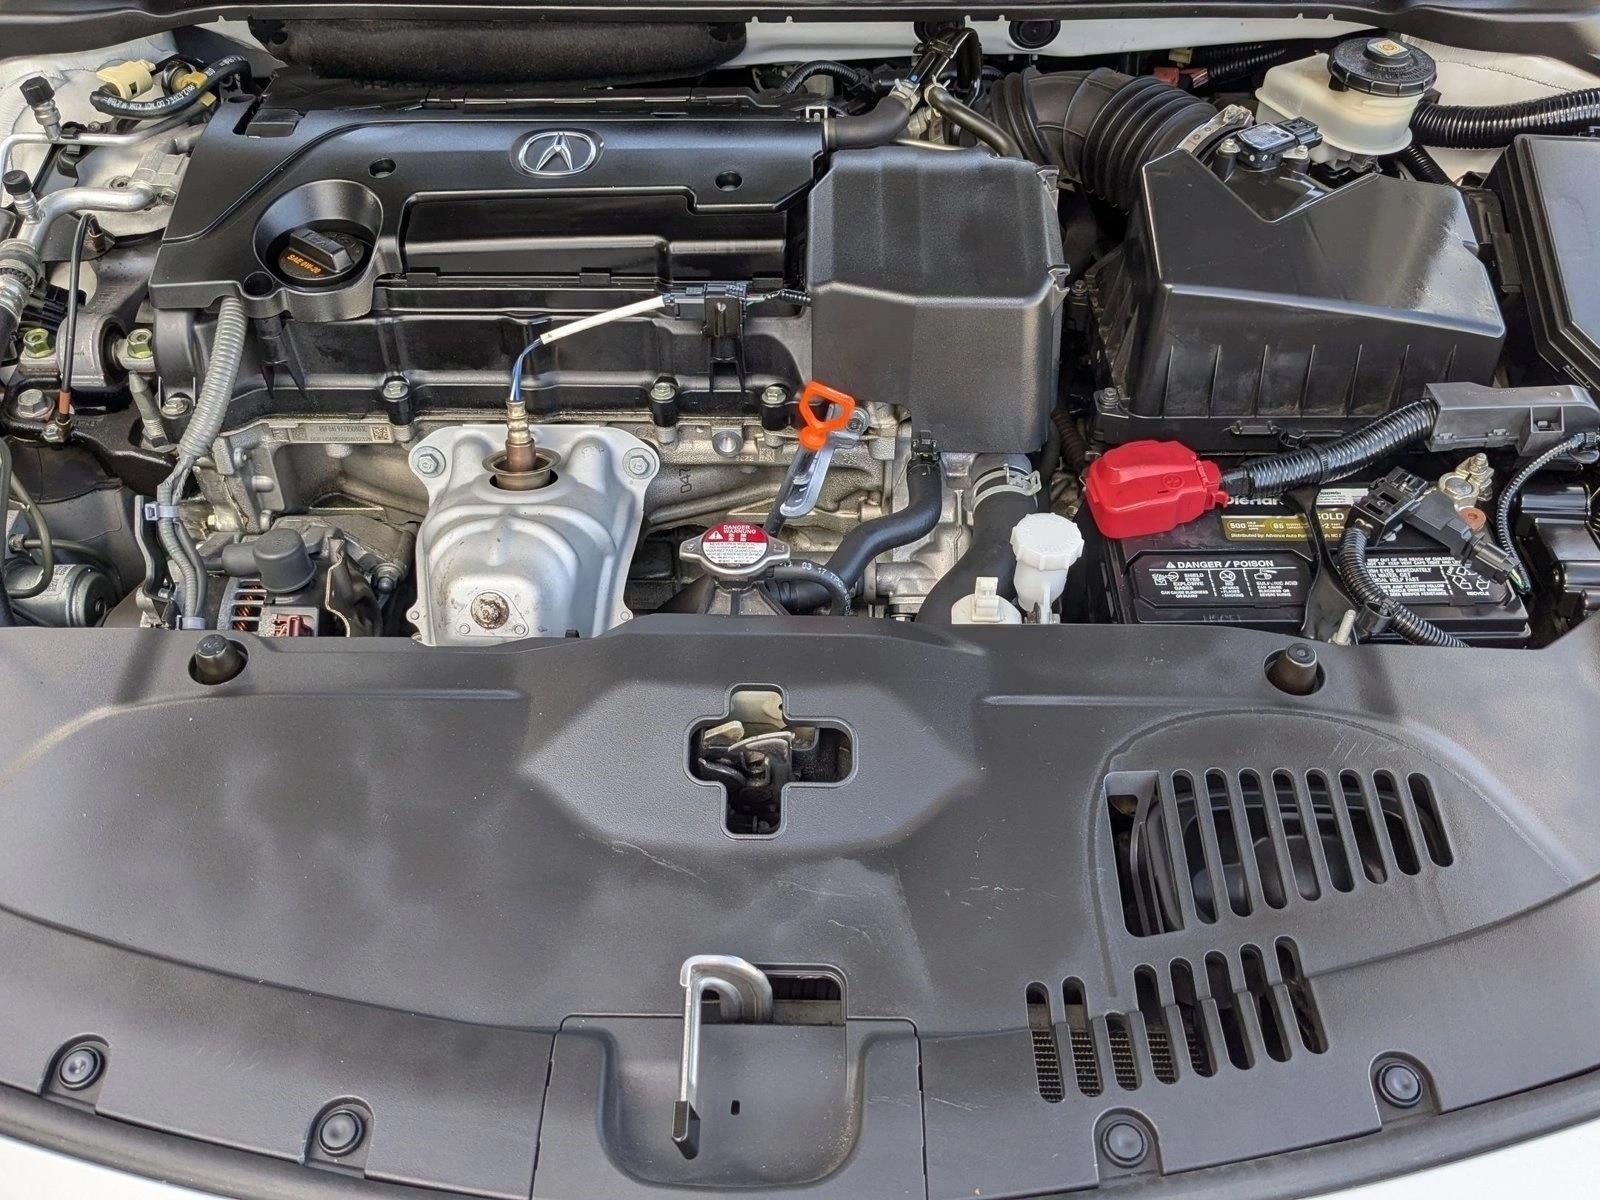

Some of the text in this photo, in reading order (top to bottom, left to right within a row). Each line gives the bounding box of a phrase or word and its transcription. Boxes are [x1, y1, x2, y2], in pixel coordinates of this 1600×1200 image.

[287, 254, 303, 265] SAE
[801, 561, 812, 571] 03
[817, 567, 827, 575] 17
[1177, 561, 1222, 569] DANGER
[1233, 560, 1275, 568] POISON
